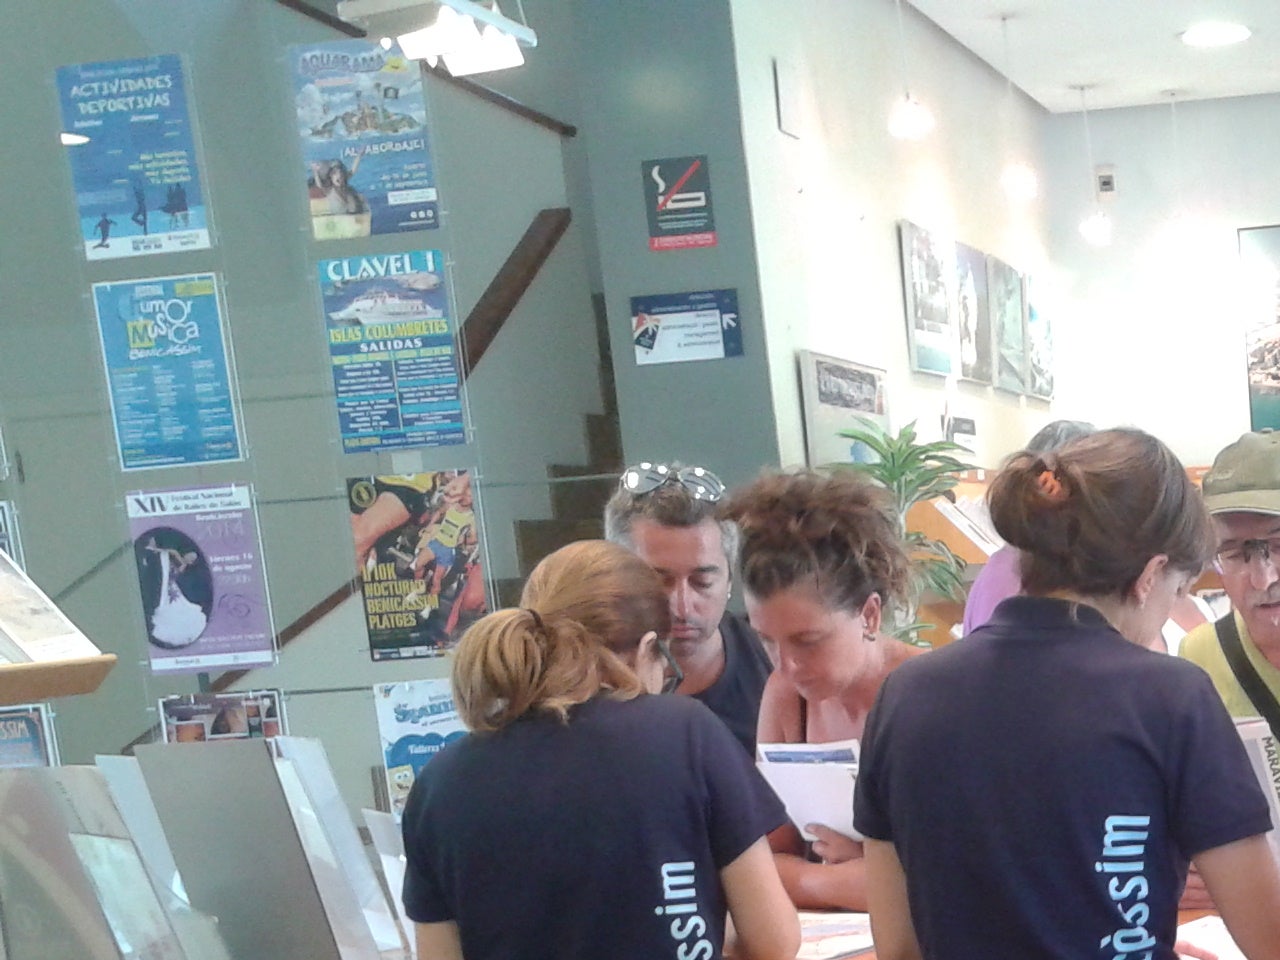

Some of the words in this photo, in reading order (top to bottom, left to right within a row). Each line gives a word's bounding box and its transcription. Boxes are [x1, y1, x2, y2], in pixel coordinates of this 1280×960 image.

[70, 74, 172, 98] ACTIVIDADES
[78, 92, 171, 114] DEPORTIVAS
[327, 252, 418, 280] CLAVEL
[426, 250, 436, 272] I
[360, 337, 423, 353] SALIDAS
[369, 612, 417, 630] PLATGES
